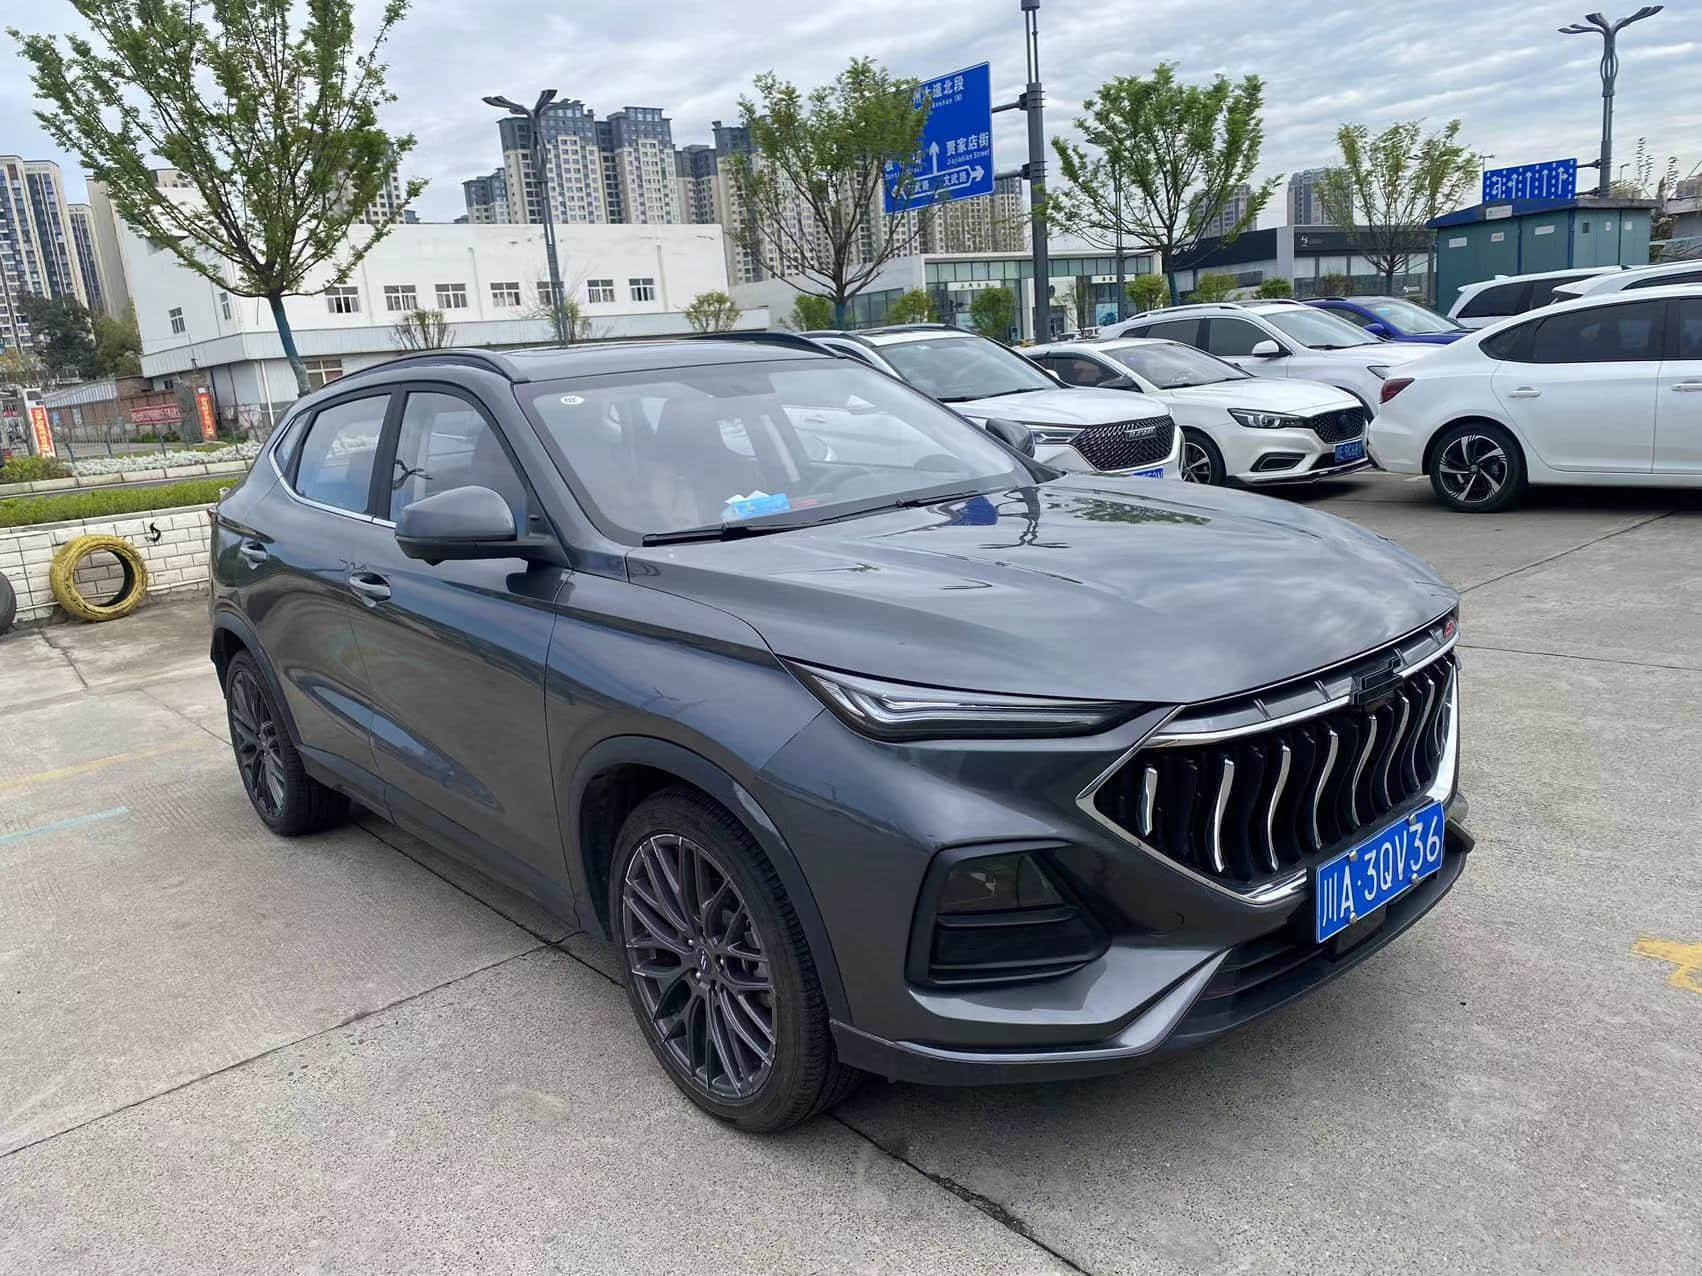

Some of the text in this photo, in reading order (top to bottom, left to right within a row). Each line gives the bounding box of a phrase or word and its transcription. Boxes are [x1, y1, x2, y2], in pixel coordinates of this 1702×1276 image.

[945, 132, 989, 157] 贾家店街
[973, 149, 990, 159] Street
